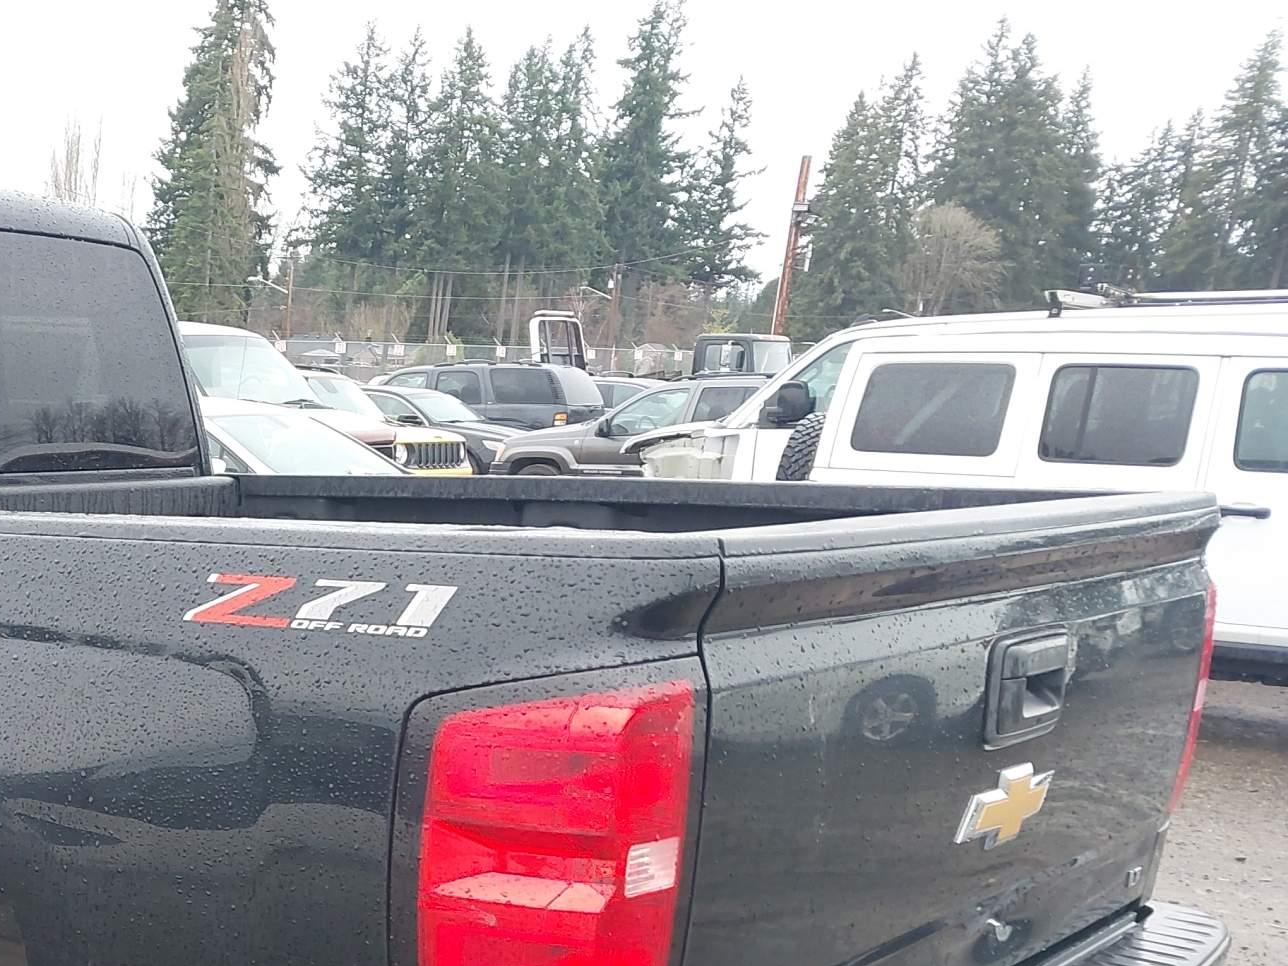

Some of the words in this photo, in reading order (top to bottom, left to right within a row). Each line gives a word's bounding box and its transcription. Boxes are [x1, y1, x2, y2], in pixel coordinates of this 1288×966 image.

[183, 573, 458, 629] Z71
[290, 619, 342, 633] OFF
[346, 622, 430, 638] ROAD
